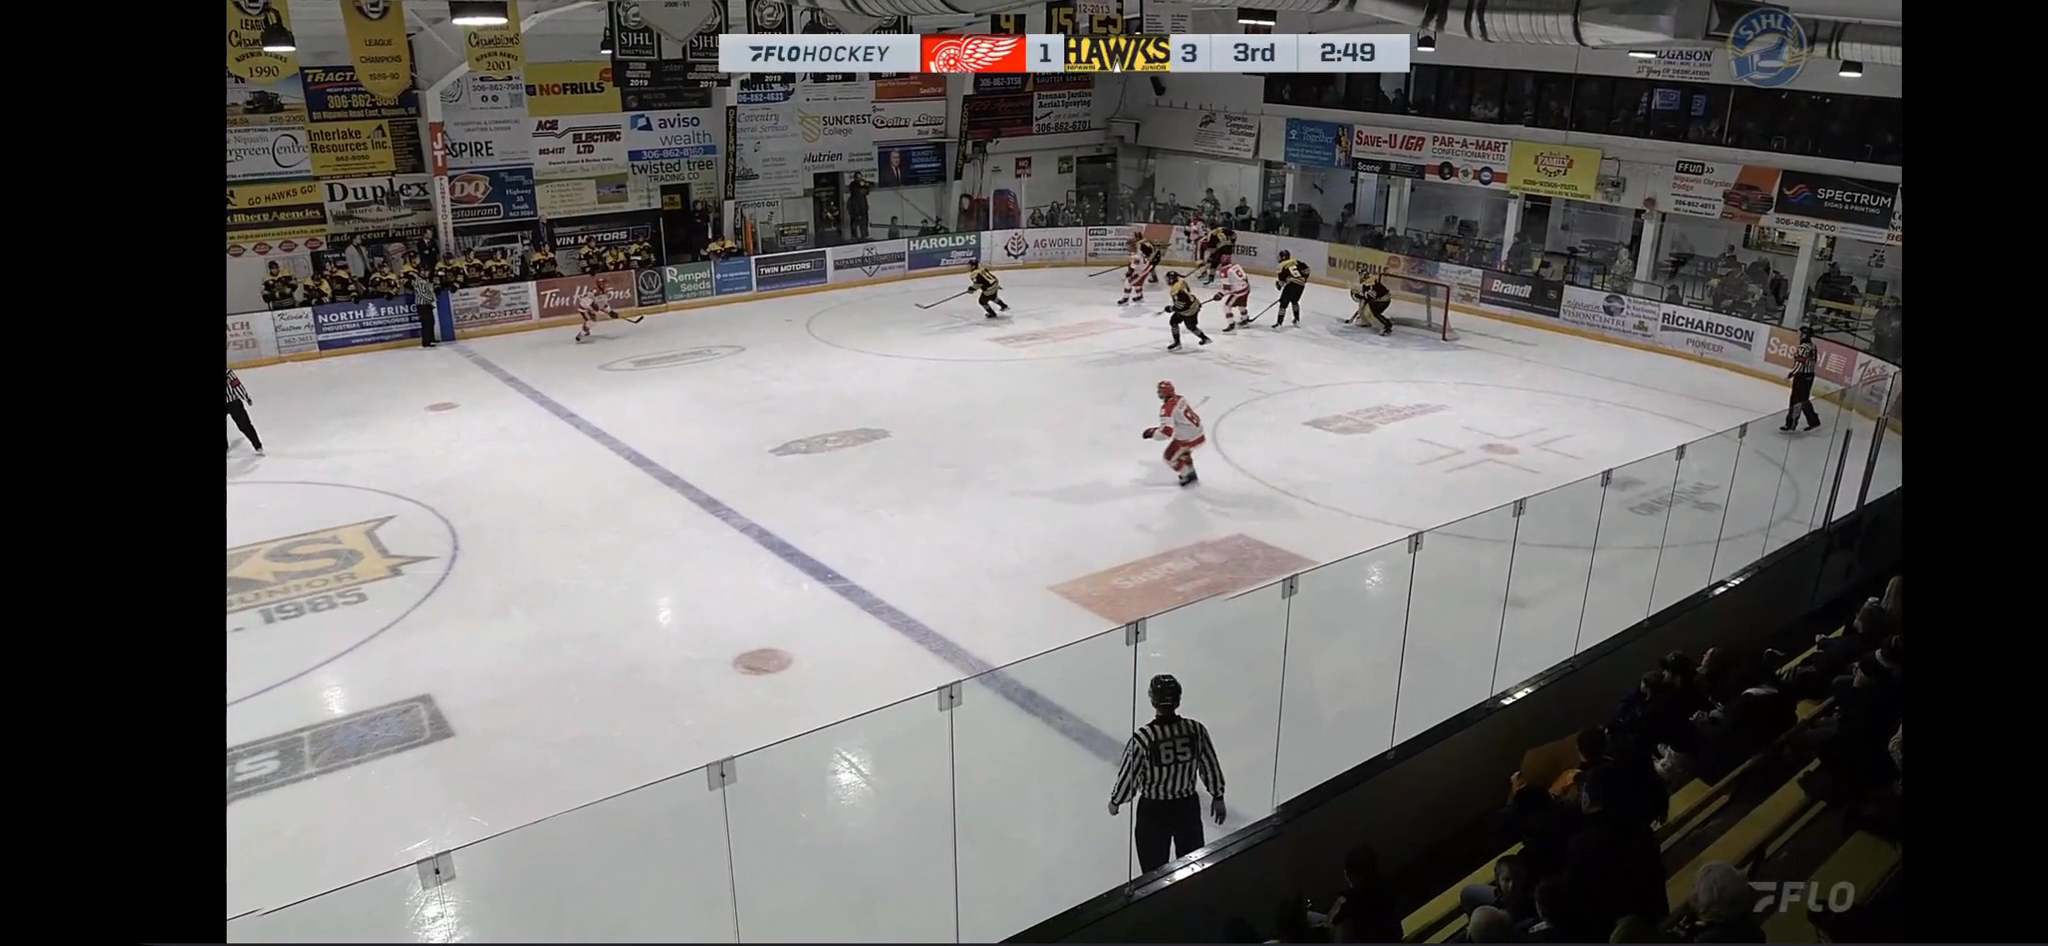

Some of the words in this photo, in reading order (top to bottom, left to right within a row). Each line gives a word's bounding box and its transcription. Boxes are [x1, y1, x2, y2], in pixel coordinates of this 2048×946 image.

[364, 38, 393, 47] LEAGUE
[620, 32, 653, 47] SJHL
[359, 55, 403, 64] CHAMPIONS
[486, 61, 511, 71] 2001
[248, 66, 279, 79] 1990
[700, 80, 718, 88] 2019
[536, 120, 559, 132] ACE
[658, 113, 701, 129] aviso
[822, 114, 872, 127] SUNCREST
[872, 115, 911, 129] Dollar
[308, 127, 362, 142] Interlake
[572, 131, 622, 144] ELECTRIC
[659, 130, 713, 146] wealth
[822, 126, 854, 138] College
[310, 141, 368, 154] Resources
[371, 139, 391, 151] Inc.
[576, 144, 595, 154] LTD
[1432, 135, 1508, 153] PAR-A-MART
[803, 151, 843, 164] Nutrien
[1431, 147, 1491, 161] CONFECTIONARY
[630, 160, 681, 175] twisted
[687, 158, 714, 171] tree
[648, 174, 685, 183] TRADING
[247, 196, 262, 206] GO
[265, 188, 299, 204] HAWKS
[300, 184, 318, 196] GO!
[325, 178, 431, 206] Duplex
[452, 180, 488, 200] DQ
[1816, 187, 1893, 208] SPECTRUM
[577, 231, 628, 244] MTORS
[909, 234, 977, 251] HAROLD'S
[1033, 238, 1047, 249] AG
[1048, 237, 1083, 248] WORLD
[666, 267, 711, 283] Rempel
[759, 266, 779, 275] TWIN
[784, 261, 812, 272] MOTORS
[681, 281, 712, 293] Seeds
[1491, 279, 1532, 299] Brandt
[539, 288, 570, 309] Tim
[318, 309, 365, 324] NORTH
[380, 303, 418, 316] FRING
[1661, 310, 1755, 343] RICHARDSON
[1686, 337, 1724, 354] PIONEER
[257, 587, 370, 625] 1985
[1159, 736, 1193, 765] 65
